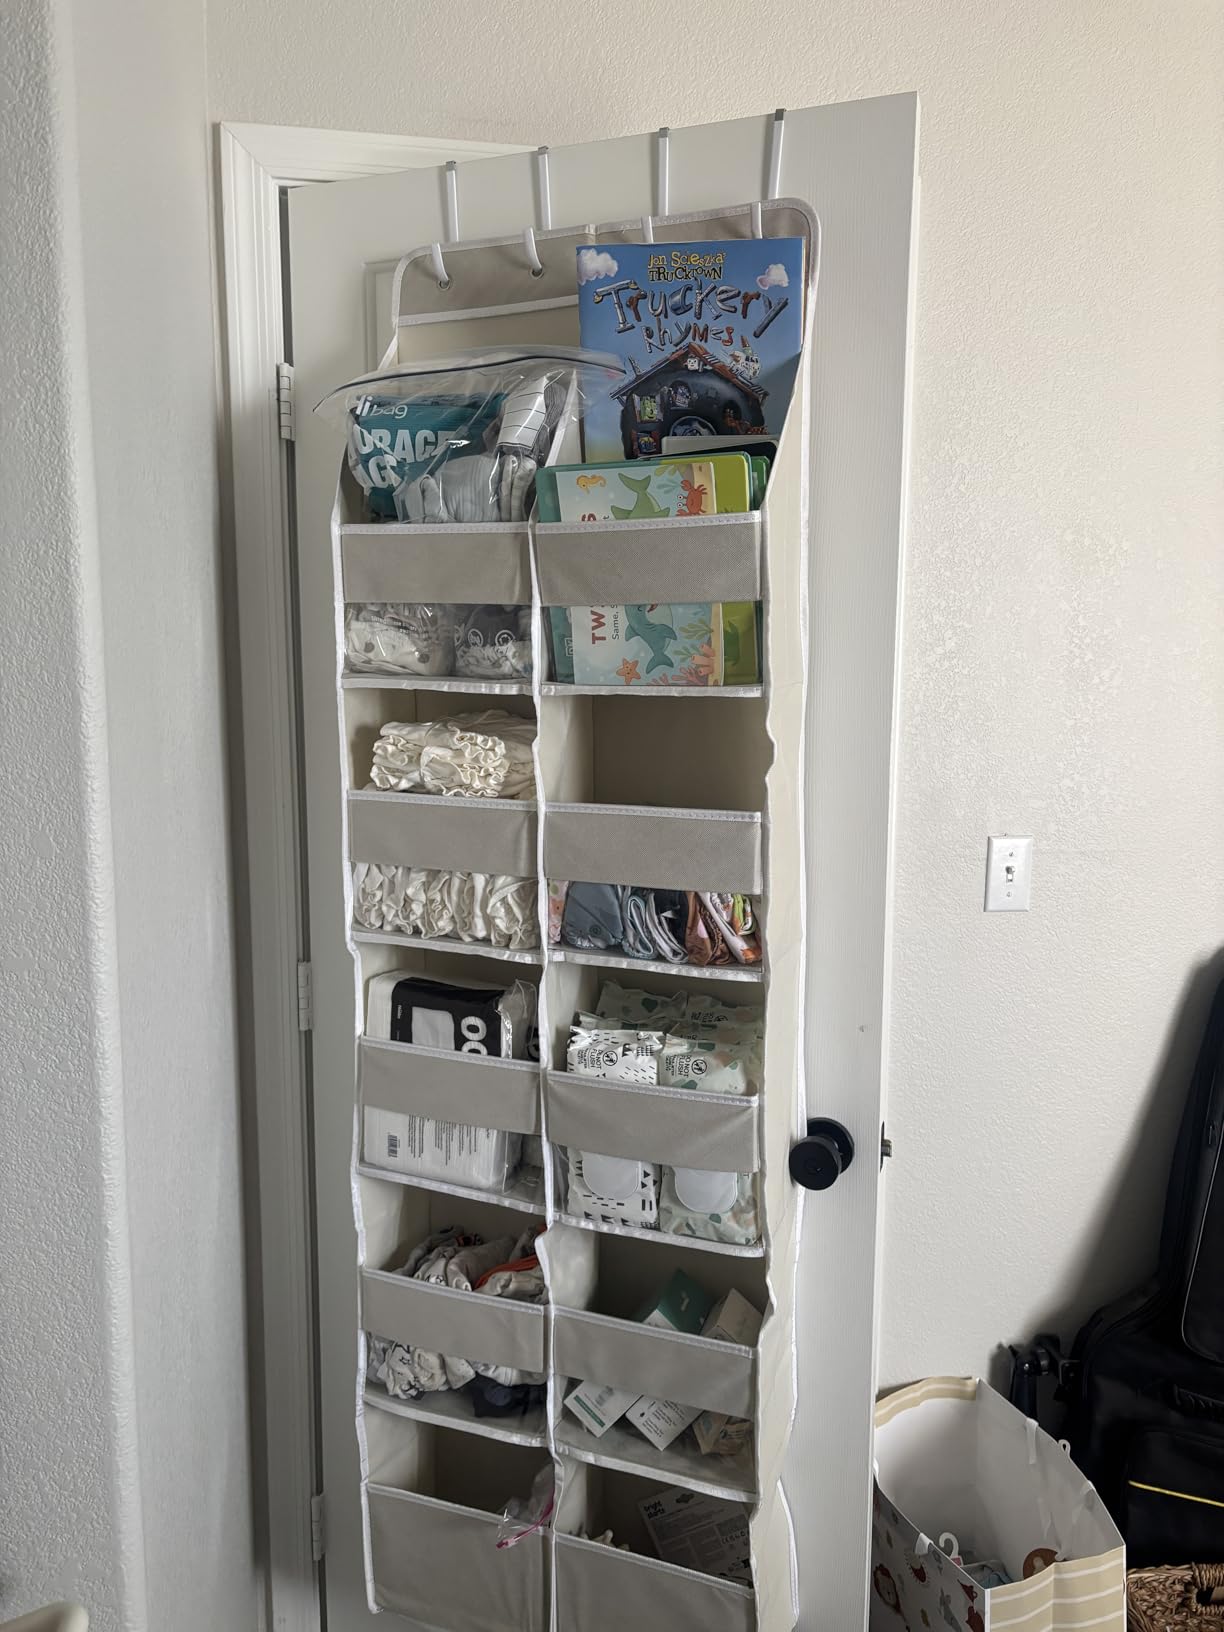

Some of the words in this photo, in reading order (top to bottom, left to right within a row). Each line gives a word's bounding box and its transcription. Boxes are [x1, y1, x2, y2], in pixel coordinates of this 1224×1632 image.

[648, 254, 667, 268] Jon
[648, 266, 722, 282] TRUCKTOWN
[593, 279, 789, 339] Truckery
[641, 318, 734, 353] Rhymes
[611, 611, 620, 640] Same,
